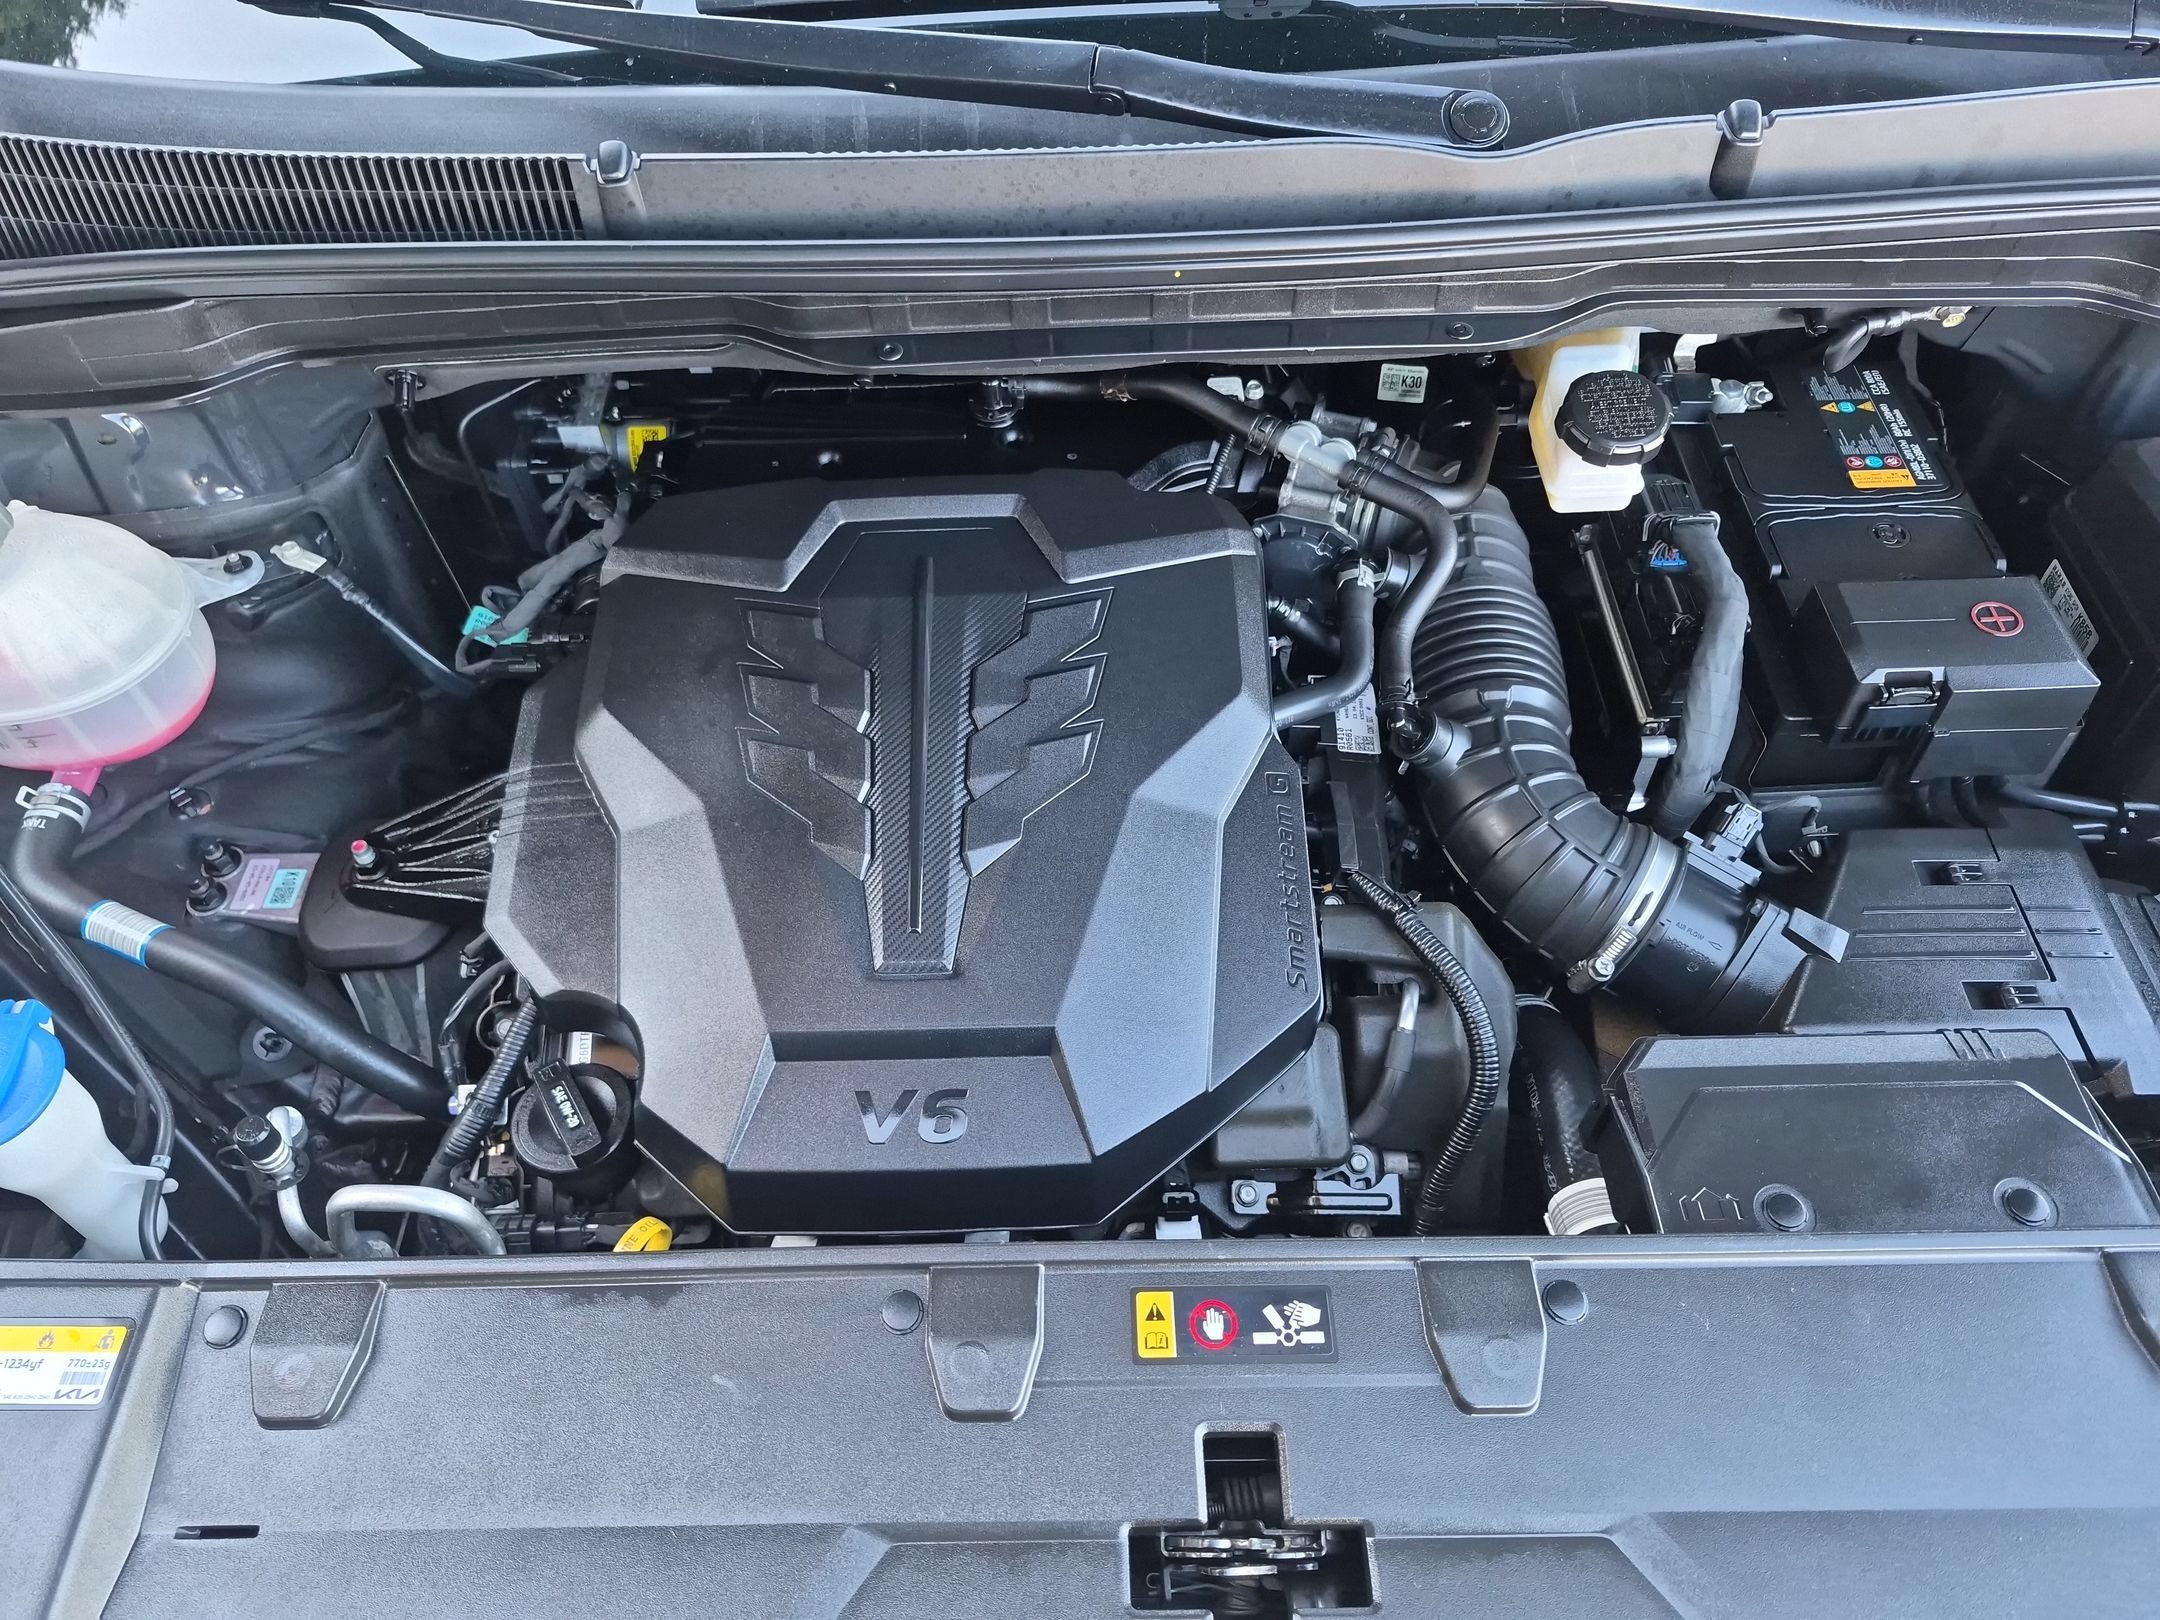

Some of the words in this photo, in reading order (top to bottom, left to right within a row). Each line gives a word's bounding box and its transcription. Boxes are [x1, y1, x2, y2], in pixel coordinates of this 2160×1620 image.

[1401, 375, 1422, 389] K30
[1337, 728, 1346, 750] 91410
[1276, 804, 1308, 993] Smartstream
[1676, 922, 1687, 931] AIR
[1686, 927, 1705, 940] FLOW
[551, 1085, 568, 1104] SAE
[559, 1100, 581, 1129] 0W-20
[854, 1088, 970, 1145] V6
[639, 1219, 659, 1233] OIL
[67, 1358, 111, 1370] 770±25g
